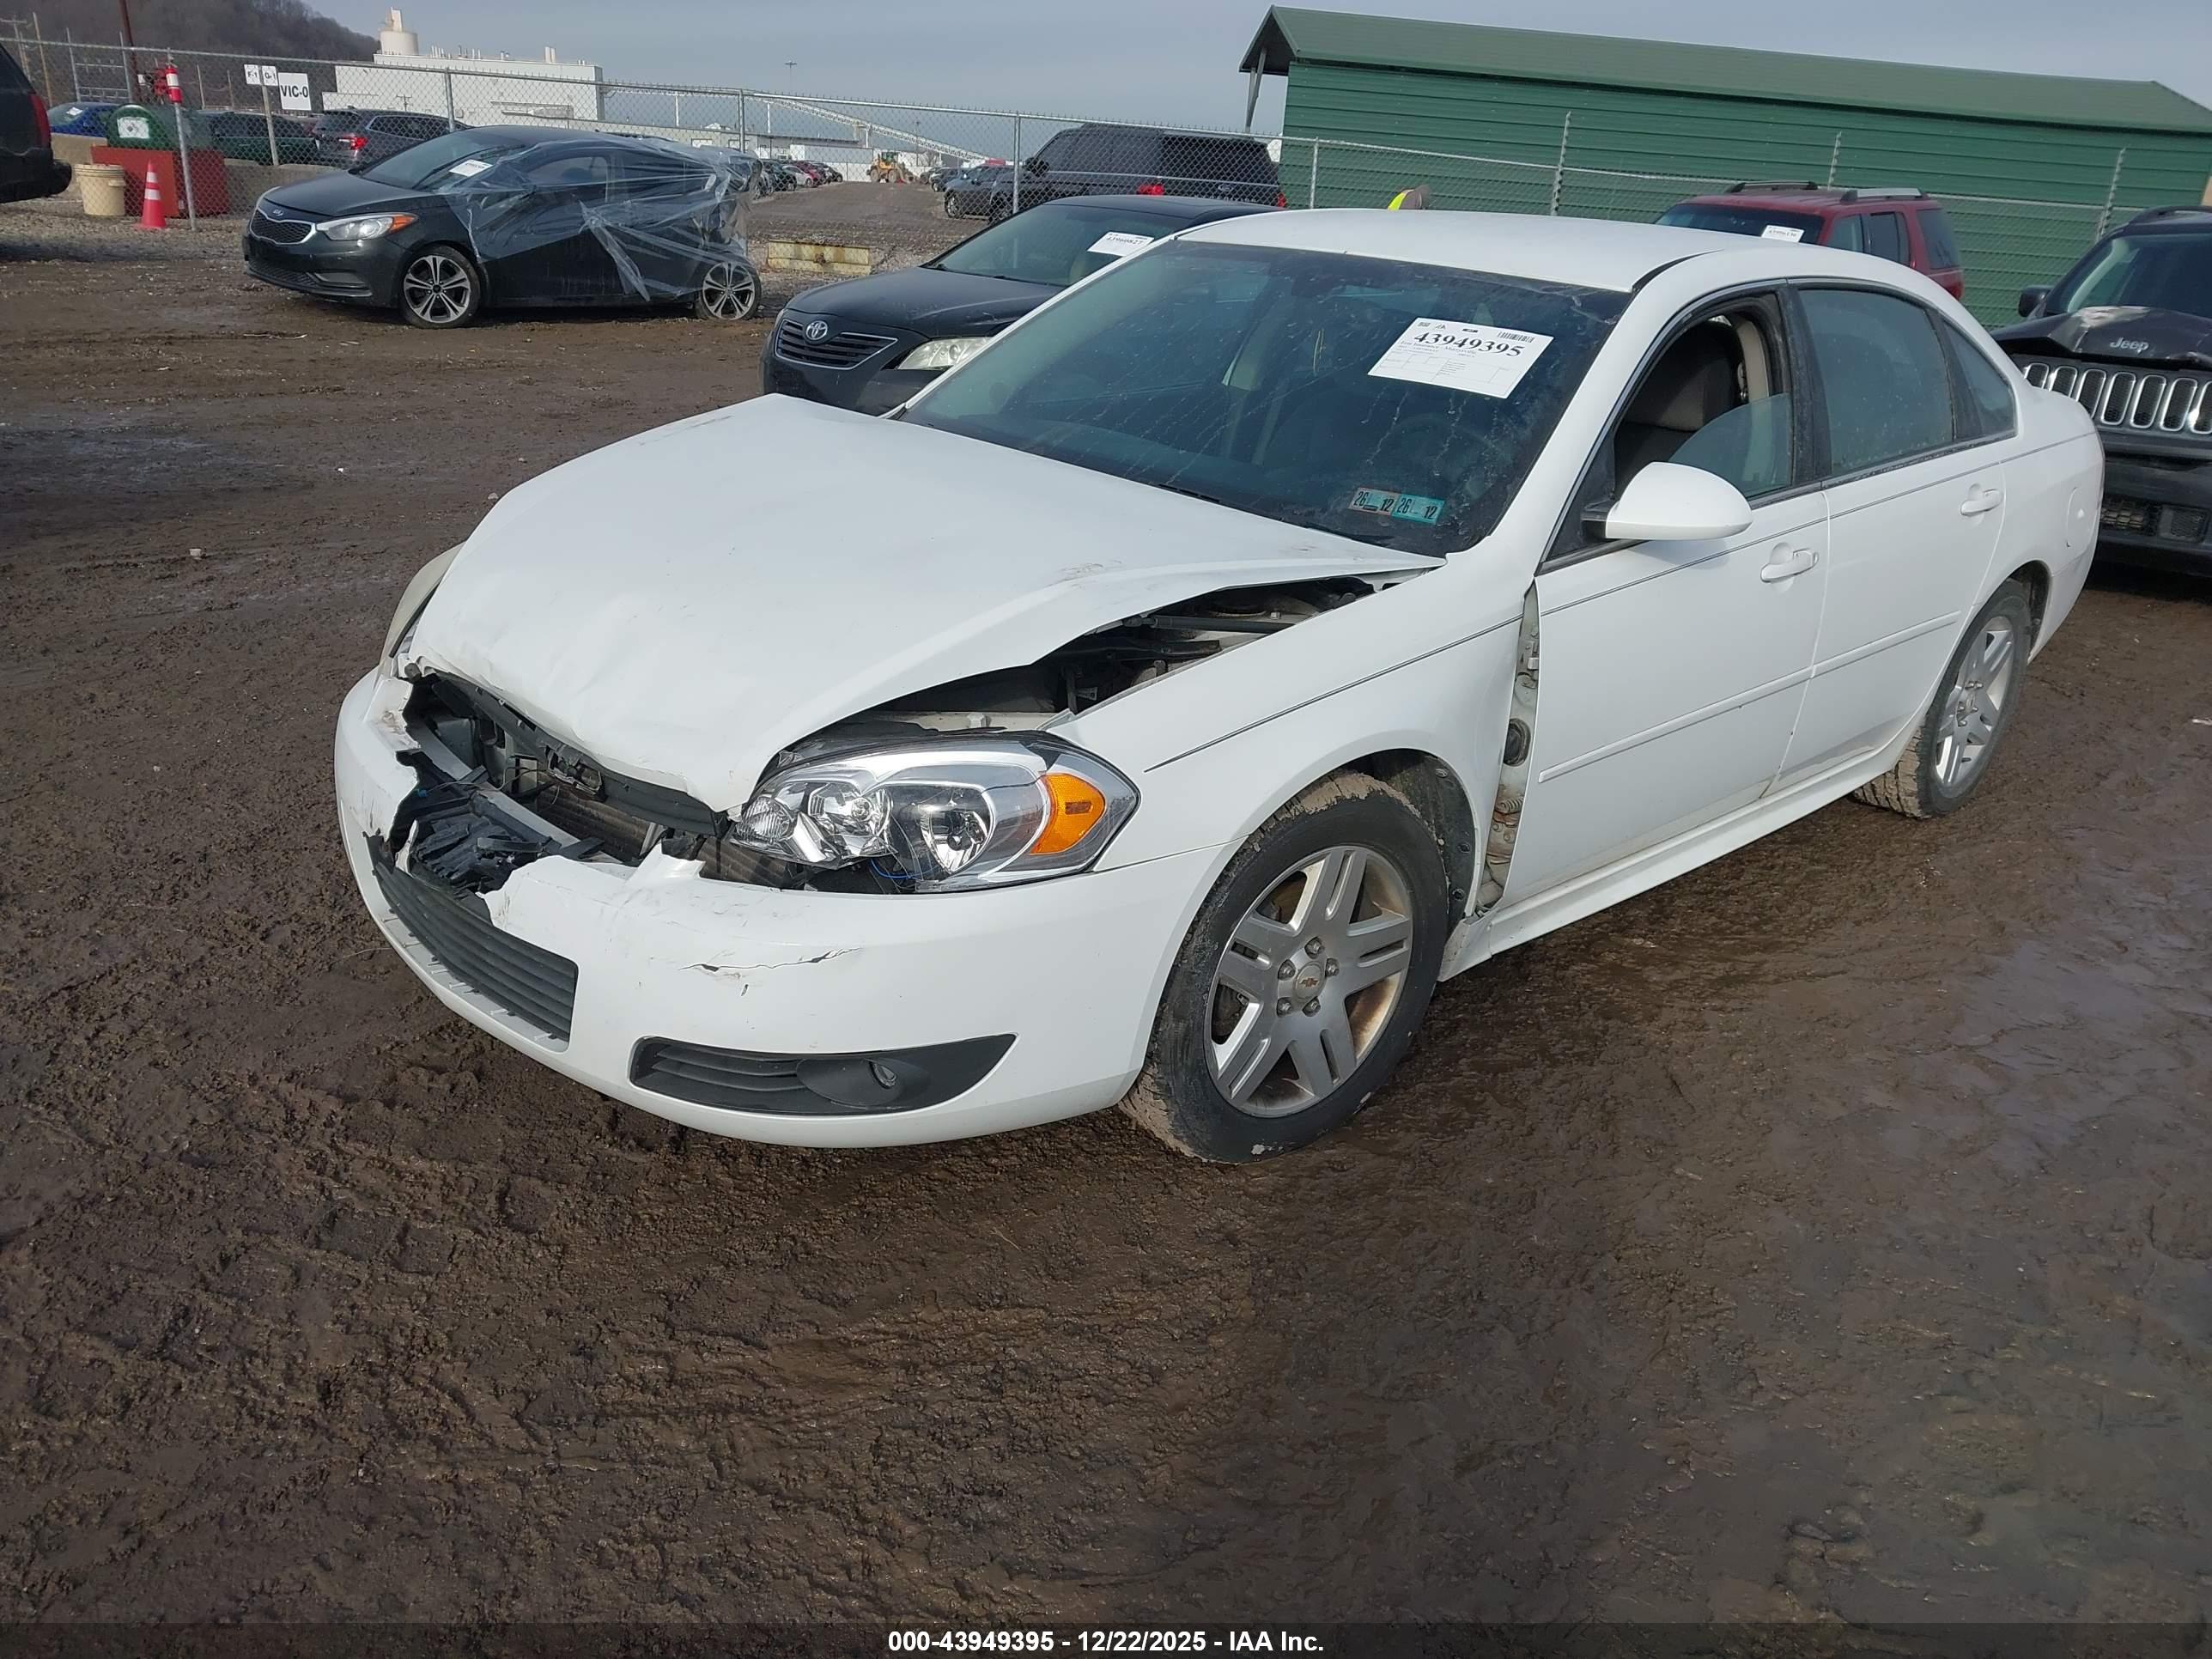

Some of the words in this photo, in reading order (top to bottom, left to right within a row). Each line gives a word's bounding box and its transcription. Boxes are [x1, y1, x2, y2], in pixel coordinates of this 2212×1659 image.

[1413, 331, 1526, 357] 43949395
[2110, 337, 2149, 354] Jeep
[1353, 491, 1370, 507] 26
[1380, 498, 1395, 512] 12
[1396, 498, 1413, 514] 26
[1424, 506, 1438, 520] 12
